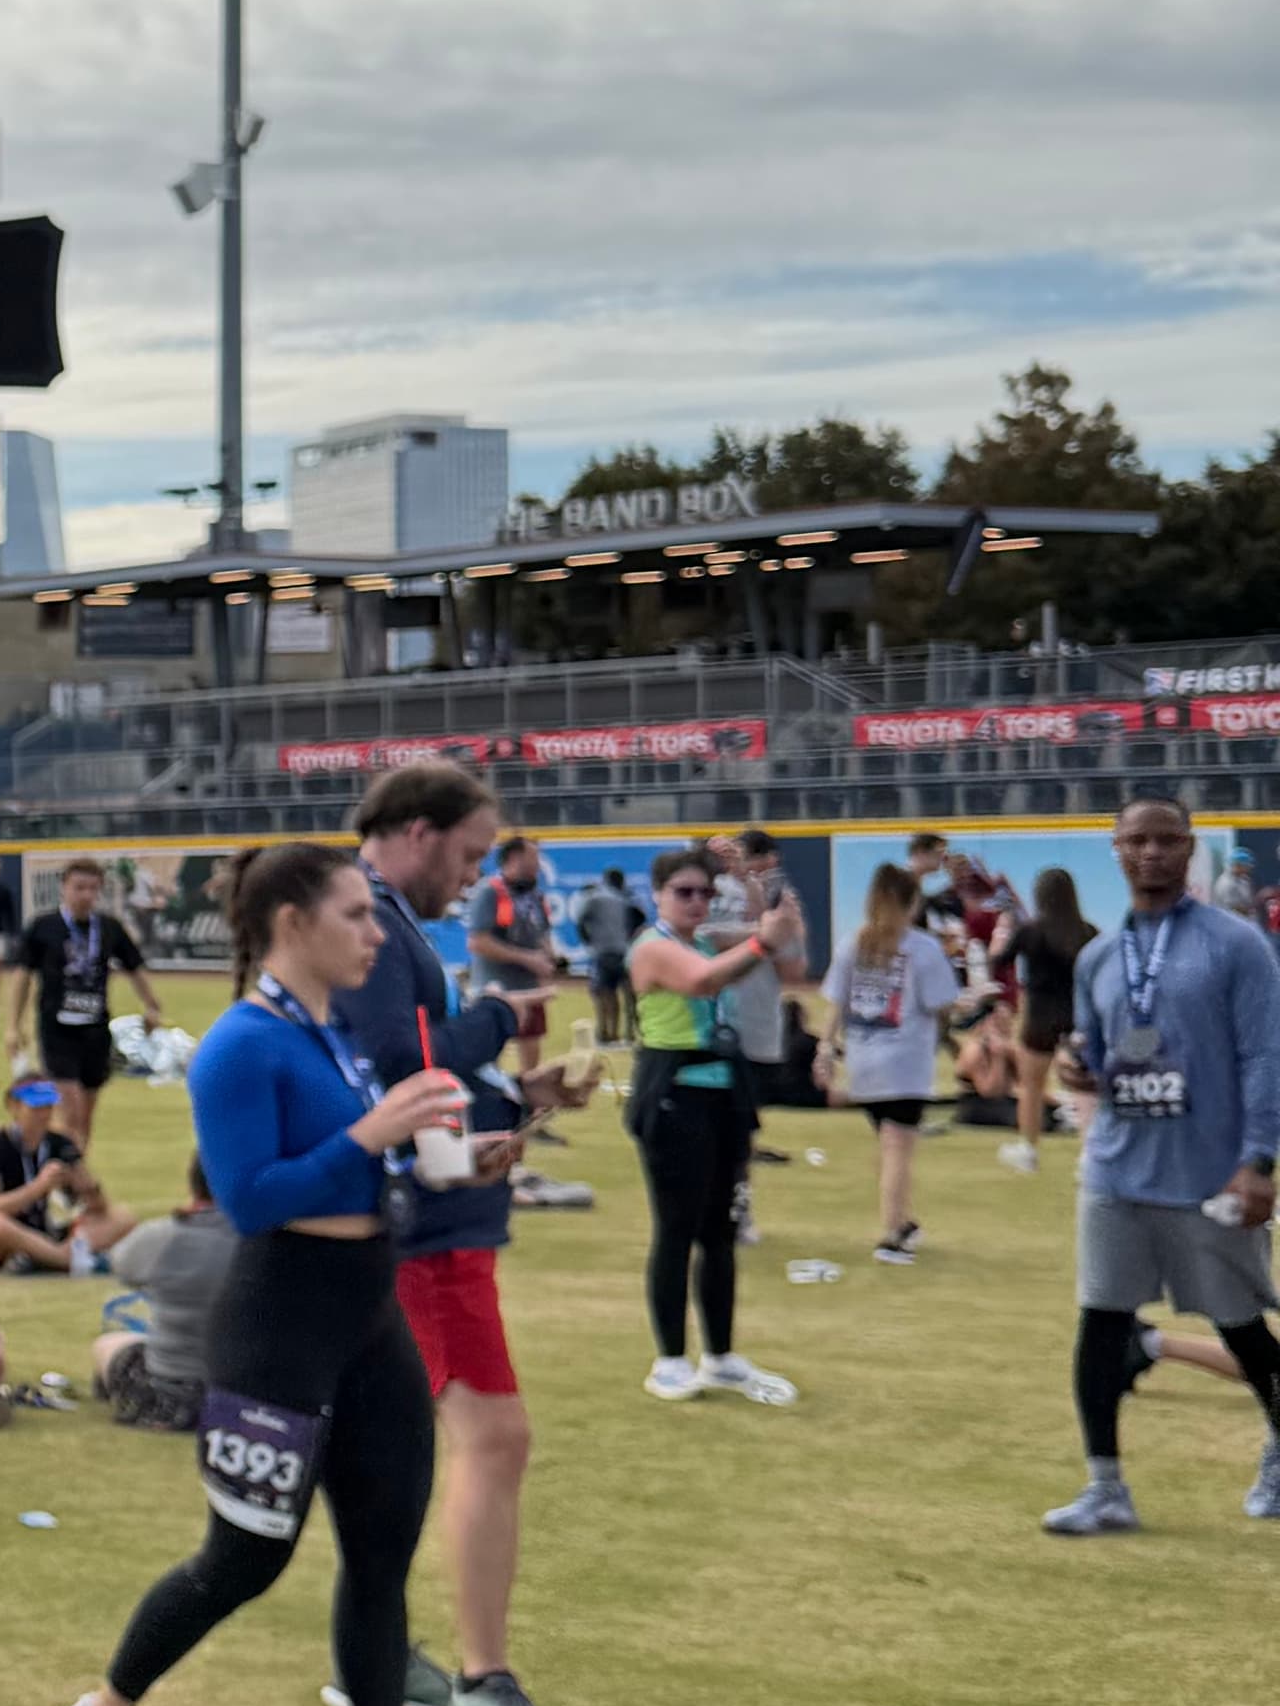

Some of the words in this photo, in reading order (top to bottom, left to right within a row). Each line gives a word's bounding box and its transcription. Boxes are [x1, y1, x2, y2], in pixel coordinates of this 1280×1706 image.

[561, 489, 668, 537] BAND
[676, 471, 762, 526] BOX
[1176, 664, 1262, 695] FIRST
[866, 717, 965, 747] TOYOTA
[1207, 701, 1280, 733] TOYO
[287, 749, 360, 773] TOYOTA
[533, 735, 618, 761] TOYOTA
[205, 1427, 304, 1494] 1393
